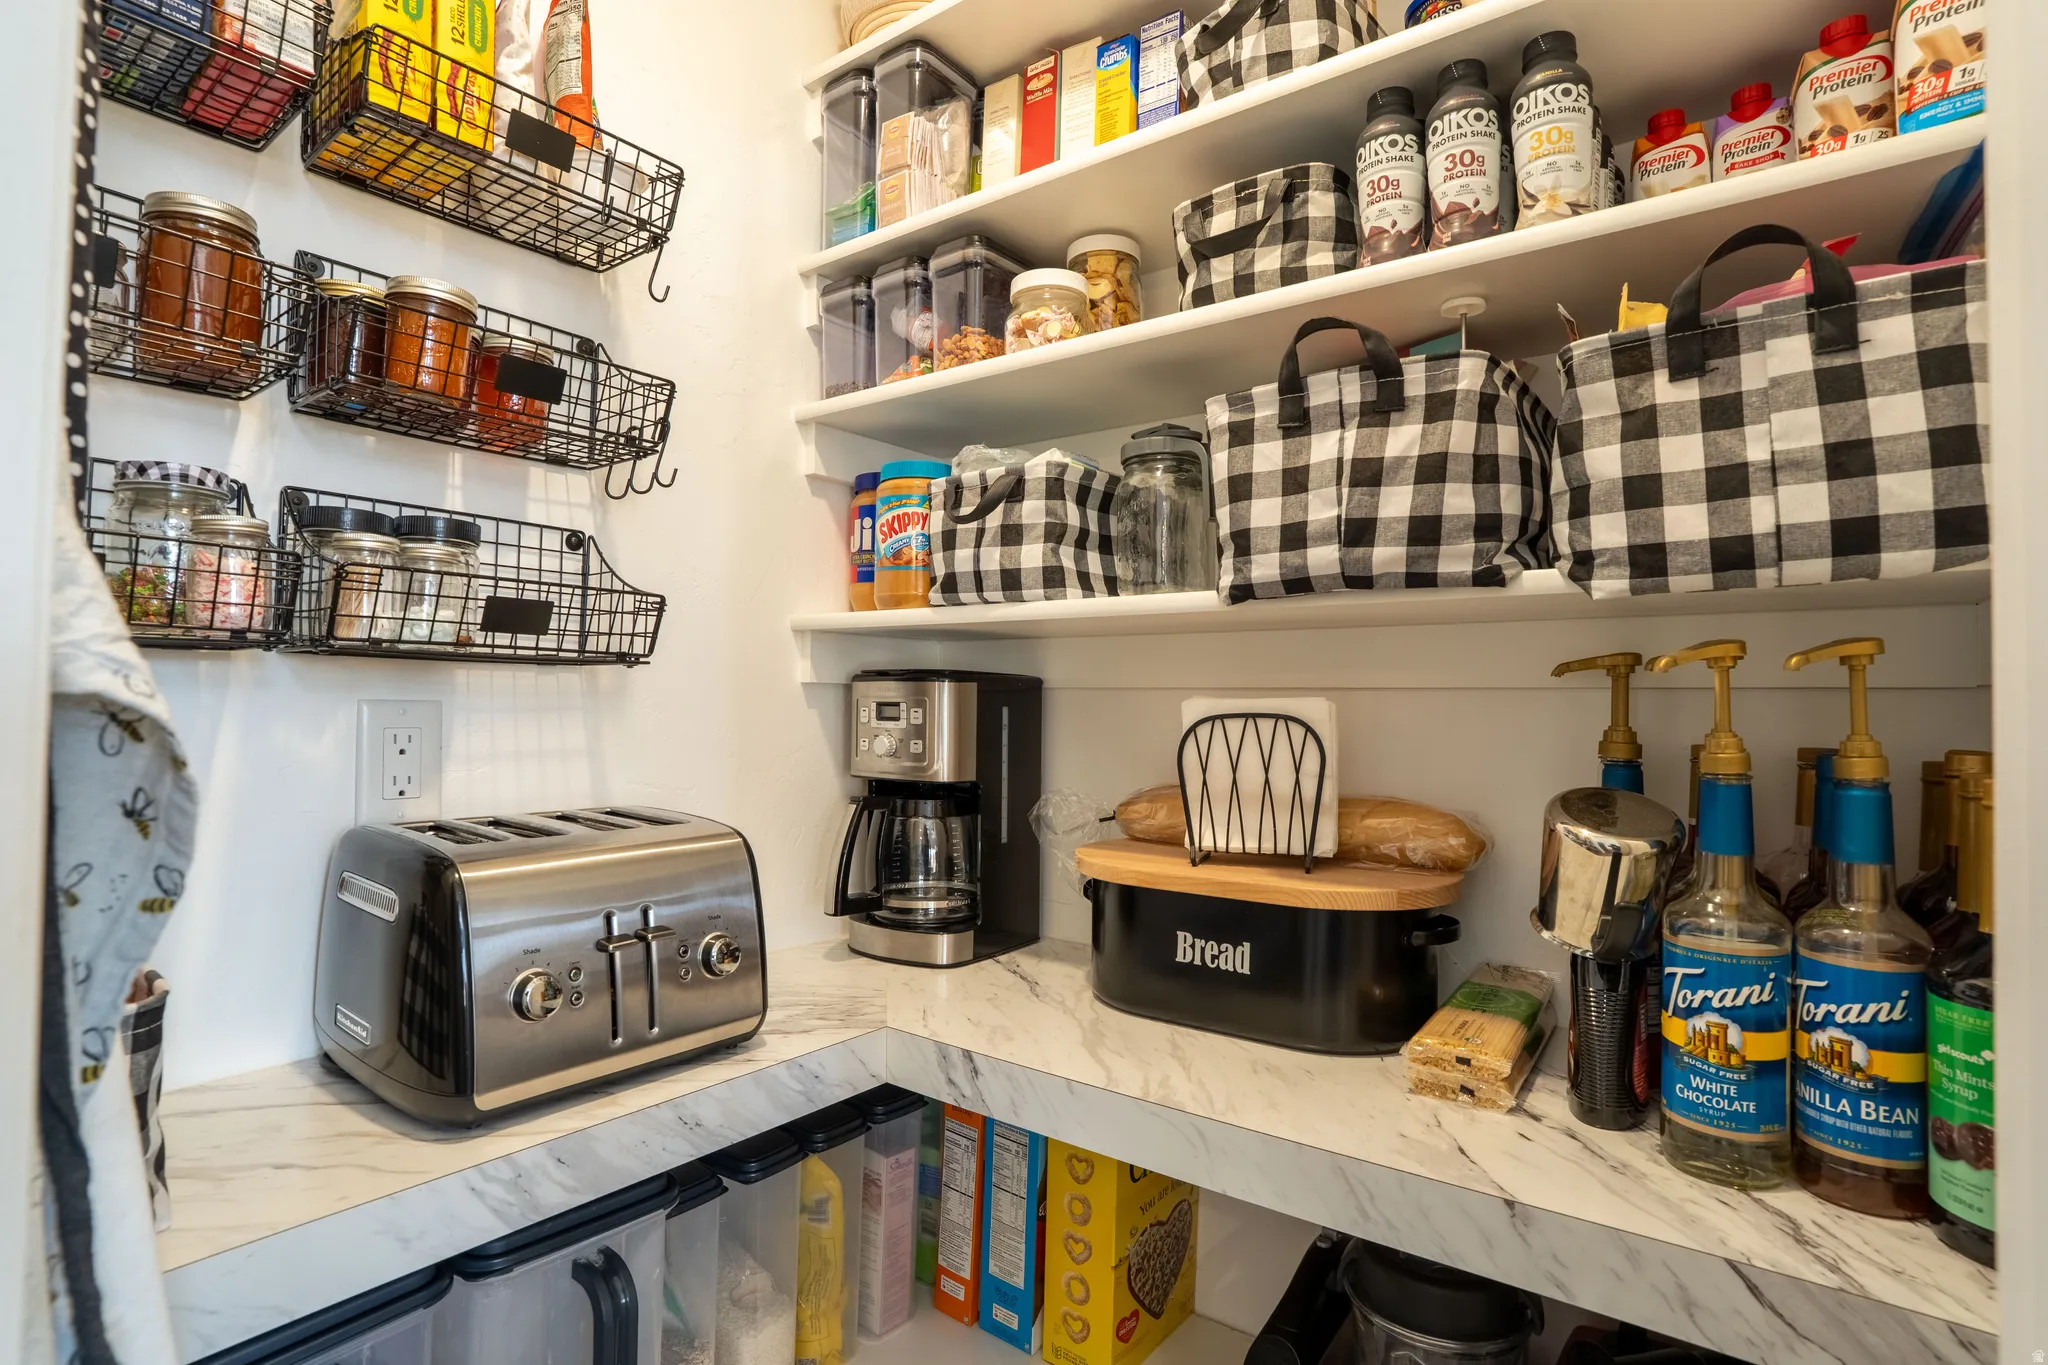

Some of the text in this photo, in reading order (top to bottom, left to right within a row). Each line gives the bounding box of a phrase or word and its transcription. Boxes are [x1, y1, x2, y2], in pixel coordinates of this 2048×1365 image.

[451, 25, 466, 47] 12
[470, 4, 483, 47] CRUNCHY
[1141, 14, 1180, 34] Nutrition Facts
[1100, 49, 1129, 69] Crumbs
[1536, 68, 1563, 79] VANILLA
[1809, 60, 1880, 92] Premier
[1912, 66, 1975, 99] 30g 1g
[1026, 86, 1054, 102] Waffle Mix
[1813, 73, 1873, 101] Protein
[1910, 87, 1943, 106] PROTEIN
[1513, 82, 1589, 122] OIKOS
[1919, 103, 1954, 120] ENERGY
[1429, 107, 1498, 142] OIKOS
[1516, 105, 1587, 130] PROTEIN SHAKE
[1431, 129, 1496, 152] PROTEIN SHAKE
[1529, 125, 1574, 152] 30g
[1721, 130, 1777, 156] Premier
[1815, 130, 1889, 156] 30g 1g 25
[1357, 133, 1419, 169] OIKOS
[1444, 149, 1485, 172] 30g
[1528, 145, 1576, 163] PROTEIN
[1638, 149, 1691, 174] Premier
[1723, 141, 1771, 163] Protein
[1734, 153, 1775, 169] BAKE SHOP
[1359, 154, 1415, 177] PROTEIN SHAKE
[1443, 168, 1487, 184] PROTEIN
[1640, 159, 1686, 181] Protein
[1366, 175, 1400, 199] 30g
[1366, 191, 1402, 208] PROTEIN
[850, 516, 873, 553] Ji
[879, 511, 929, 544] SKIPPY
[889, 537, 911, 553] CREAMY
[523, 947, 541, 955] Shade
[1175, 930, 1251, 975] Bread
[1694, 953, 1737, 964] ORIGINALE
[1664, 966, 1776, 1018] Torani
[1786, 976, 1909, 1030] Torani
[336, 1012, 367, 1038] KitchenAid
[1683, 1055, 1748, 1080] SUGAR FREE
[1806, 1060, 1875, 1090] SUGAR FREE
[1933, 1058, 1997, 1091] Thin Mints
[1689, 1073, 1738, 1098] WHITE
[1941, 1077, 1979, 1101] Syrup
[1675, 1083, 1757, 1114] CHOCOLATE
[1796, 1079, 1852, 1117] ANILLA
[1860, 1099, 1919, 1125] BEAN
[1690, 1113, 1737, 1129] SINCE 1925
[1698, 1106, 1727, 1117] SYRUP
[1813, 1130, 1862, 1149] SINCE 1925
[1849, 1121, 1867, 1134] OTHER
[1868, 1125, 1892, 1138] NATURAL
[1139, 1185, 1169, 1216] You are
